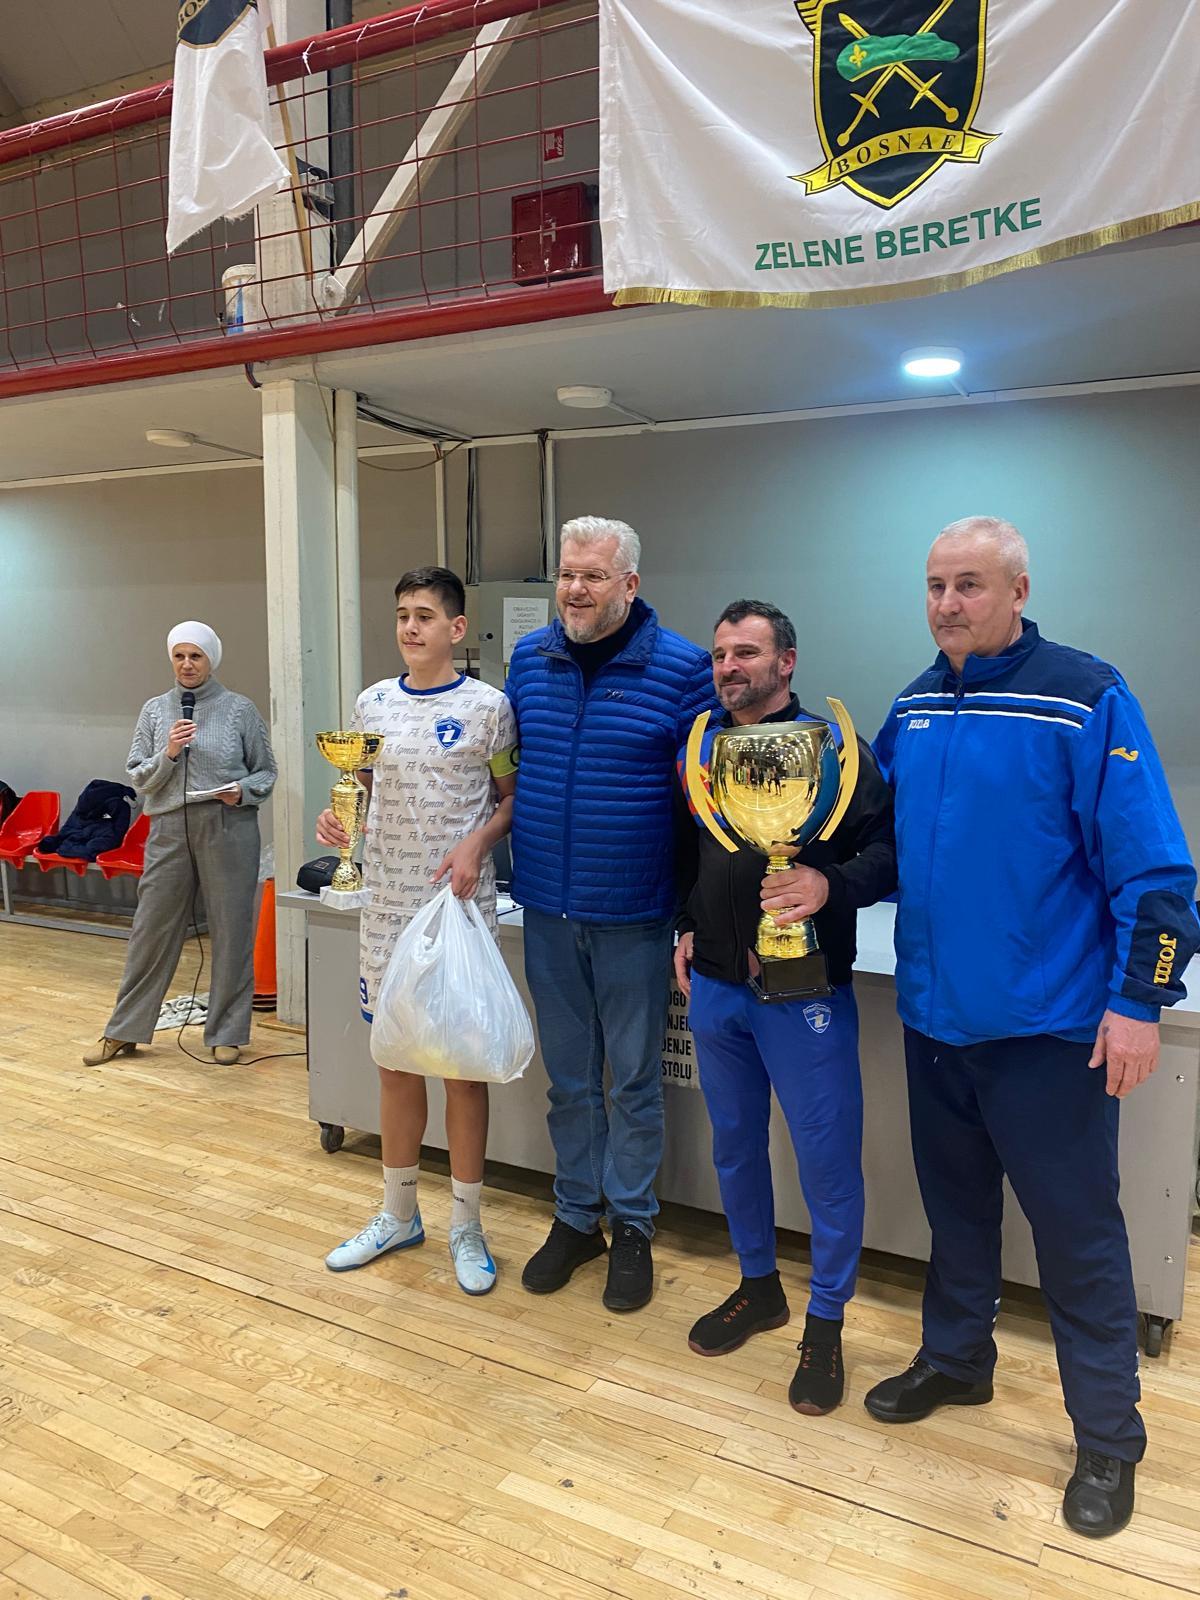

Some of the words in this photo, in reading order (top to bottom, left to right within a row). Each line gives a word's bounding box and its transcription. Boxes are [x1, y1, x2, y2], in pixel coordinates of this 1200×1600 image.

[836, 132, 957, 175] BOSNAE
[754, 234, 865, 271] ZELENE
[875, 197, 1042, 260] BERETKE
[1153, 933, 1177, 986] Jom
[661, 1060, 691, 1079] STOLU
